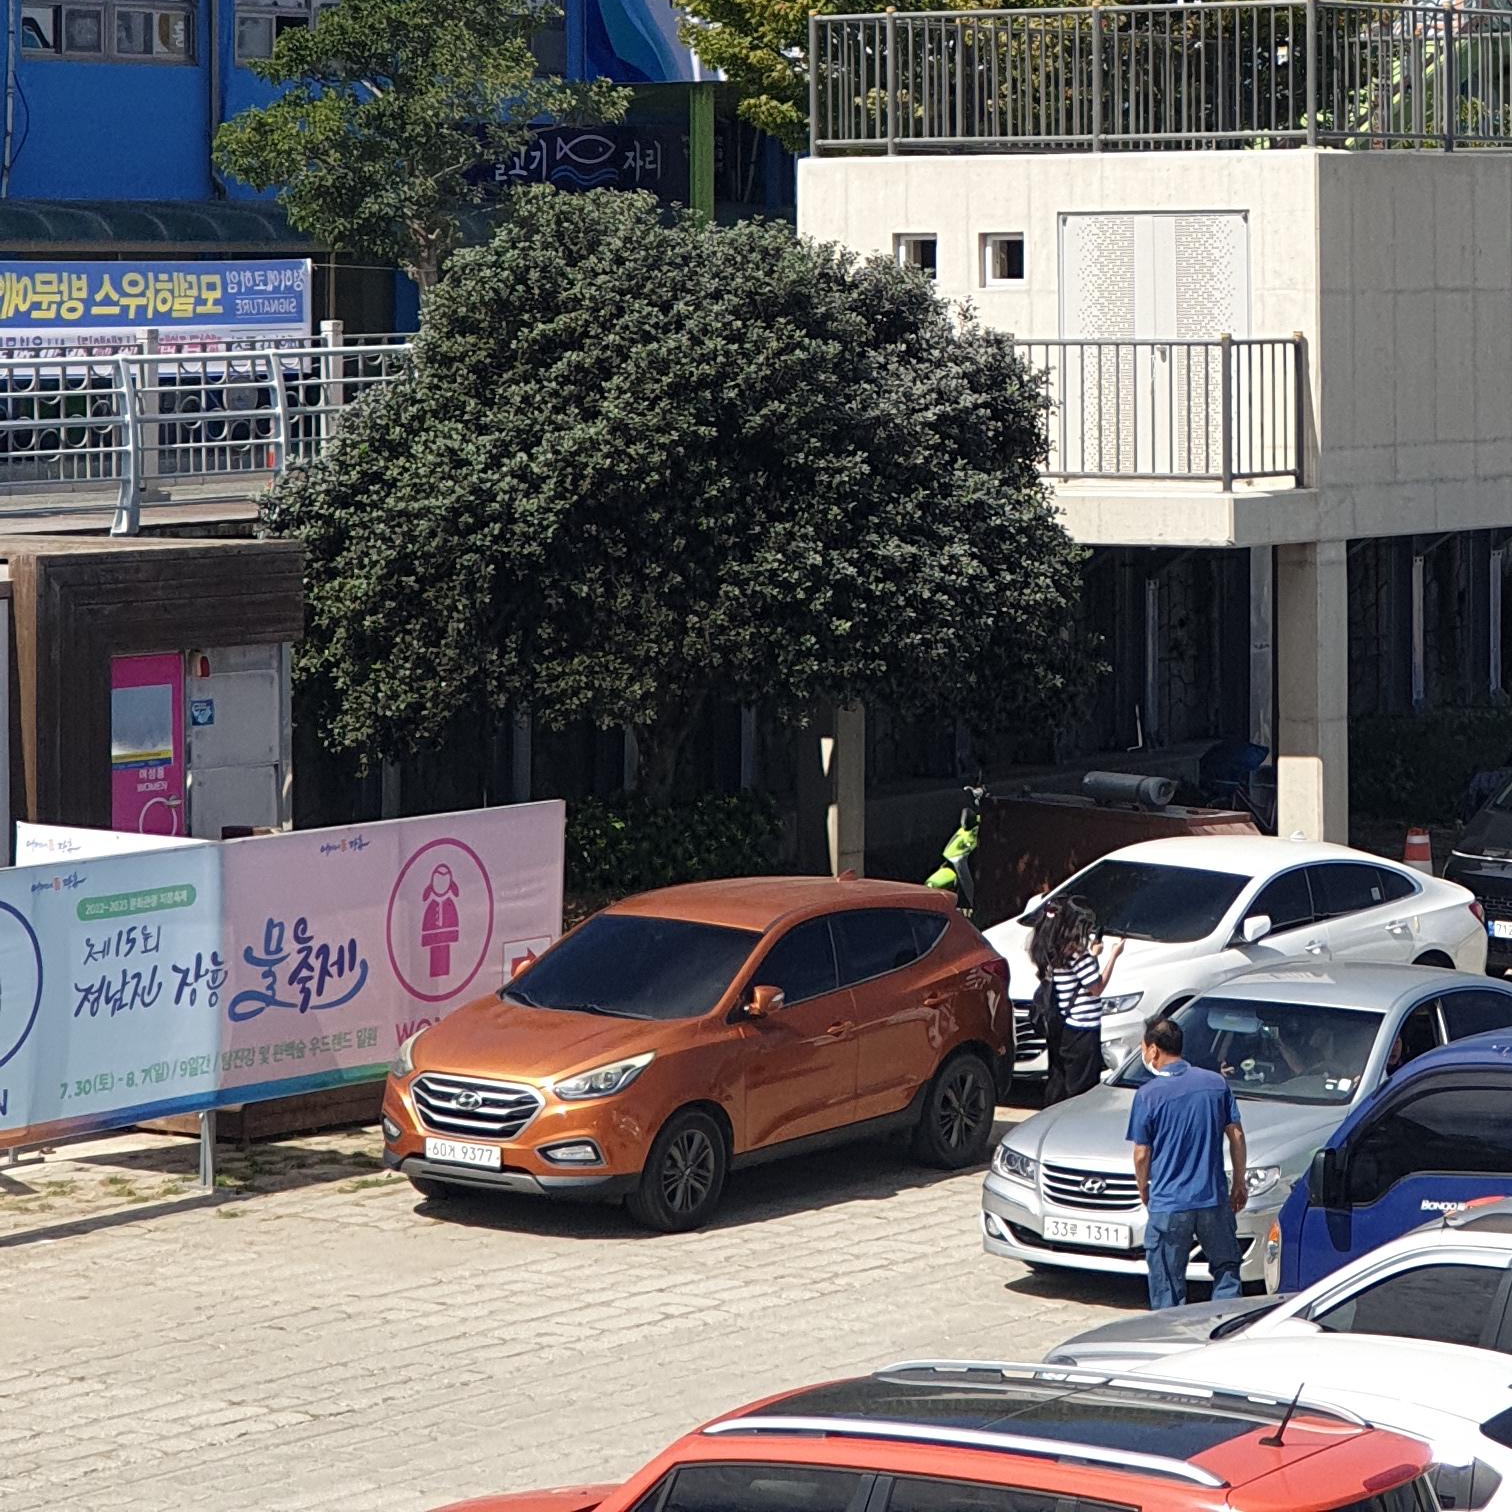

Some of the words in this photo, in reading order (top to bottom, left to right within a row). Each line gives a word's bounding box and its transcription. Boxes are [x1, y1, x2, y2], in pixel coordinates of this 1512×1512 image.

[623, 140, 662, 182] 자리
[82, 925, 161, 965] 제15회
[74, 964, 163, 1018] 정남진
[461, 1145, 493, 1163] 9377
[1086, 1224, 1119, 1243] 1311
